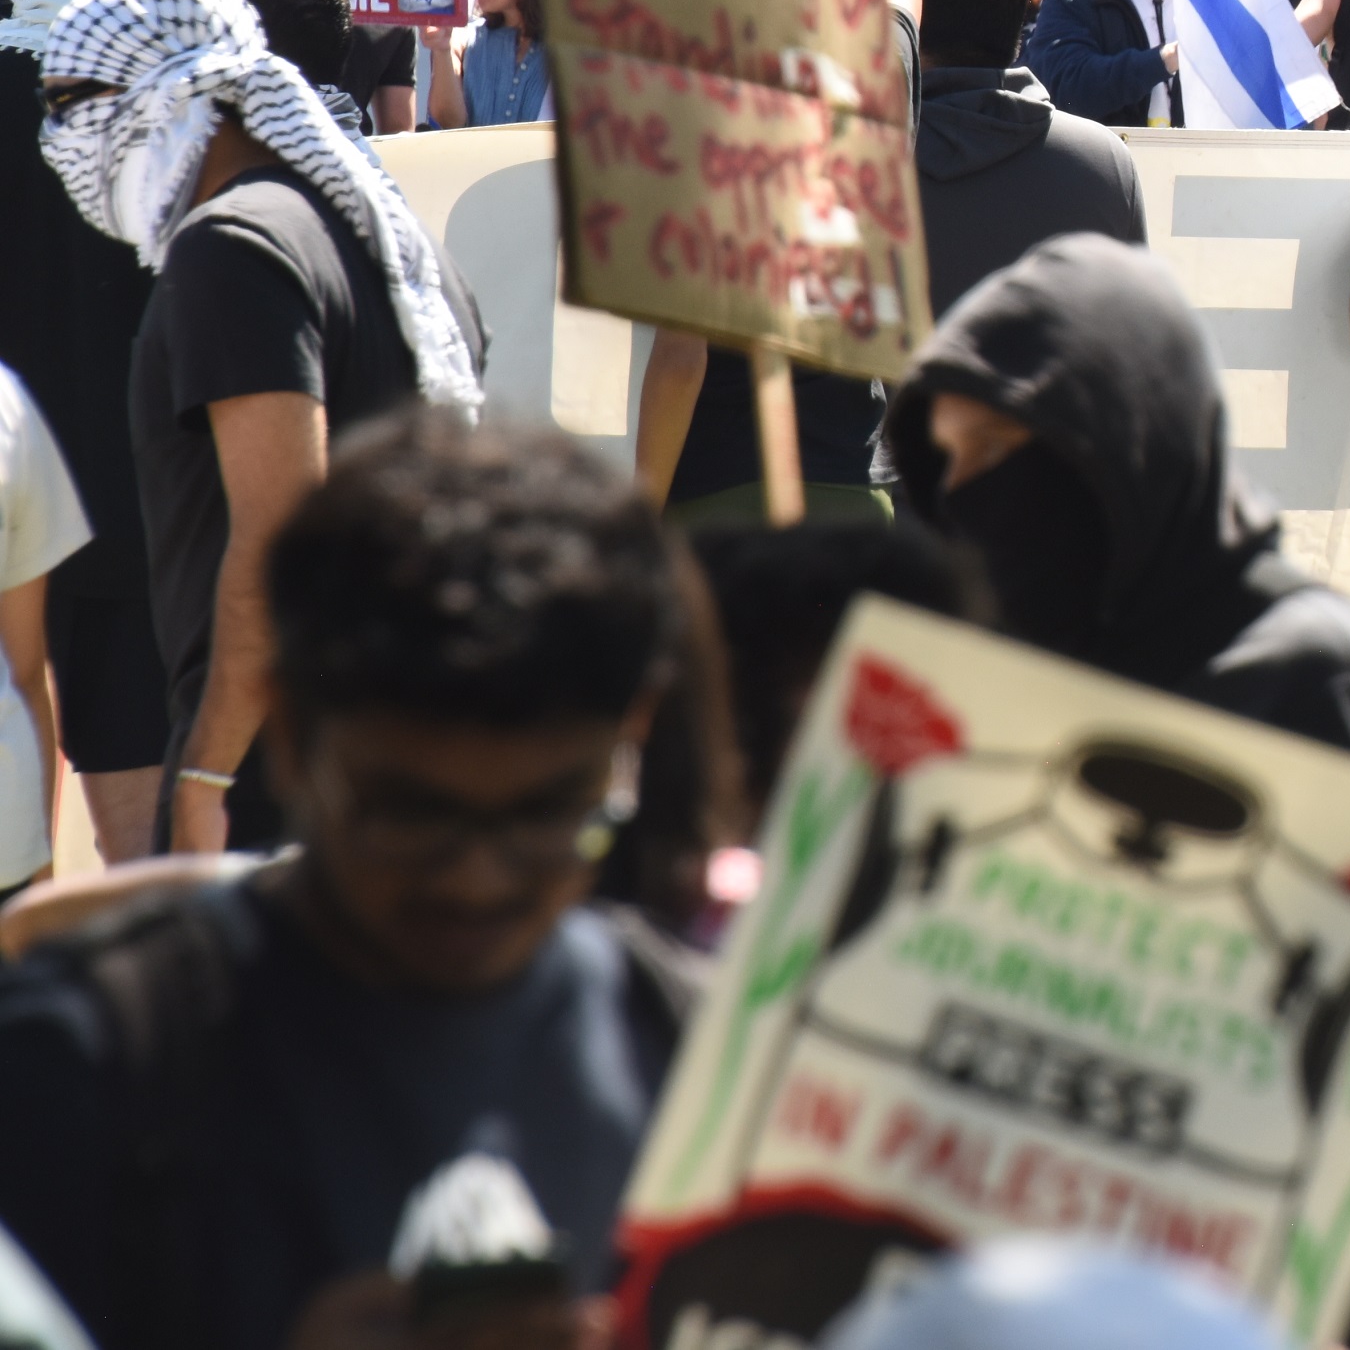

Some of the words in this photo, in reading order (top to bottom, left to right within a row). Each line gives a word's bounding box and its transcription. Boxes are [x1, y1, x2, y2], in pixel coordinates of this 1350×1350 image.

[977, 854, 1258, 982] PROTECT
[898, 914, 1280, 1086] JOURNALISTS
[939, 1025, 1185, 1140] PRESS
[776, 1073, 856, 1148] IN
[876, 1103, 1253, 1280] PALESTINE
